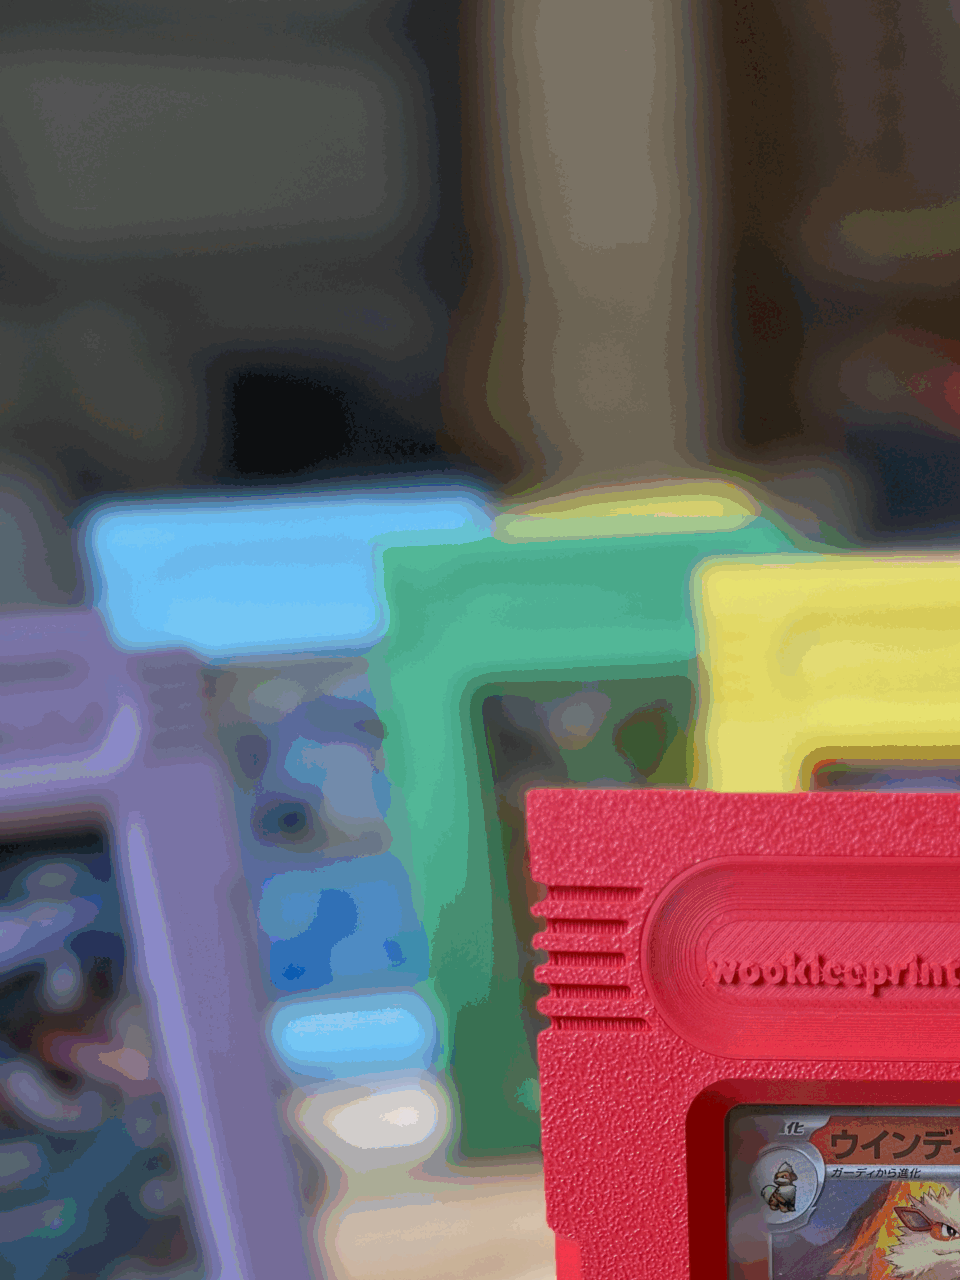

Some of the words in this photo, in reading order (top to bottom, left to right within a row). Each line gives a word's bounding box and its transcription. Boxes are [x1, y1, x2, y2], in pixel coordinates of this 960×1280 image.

[831, 1167, 922, 1179] ガーディから進化
